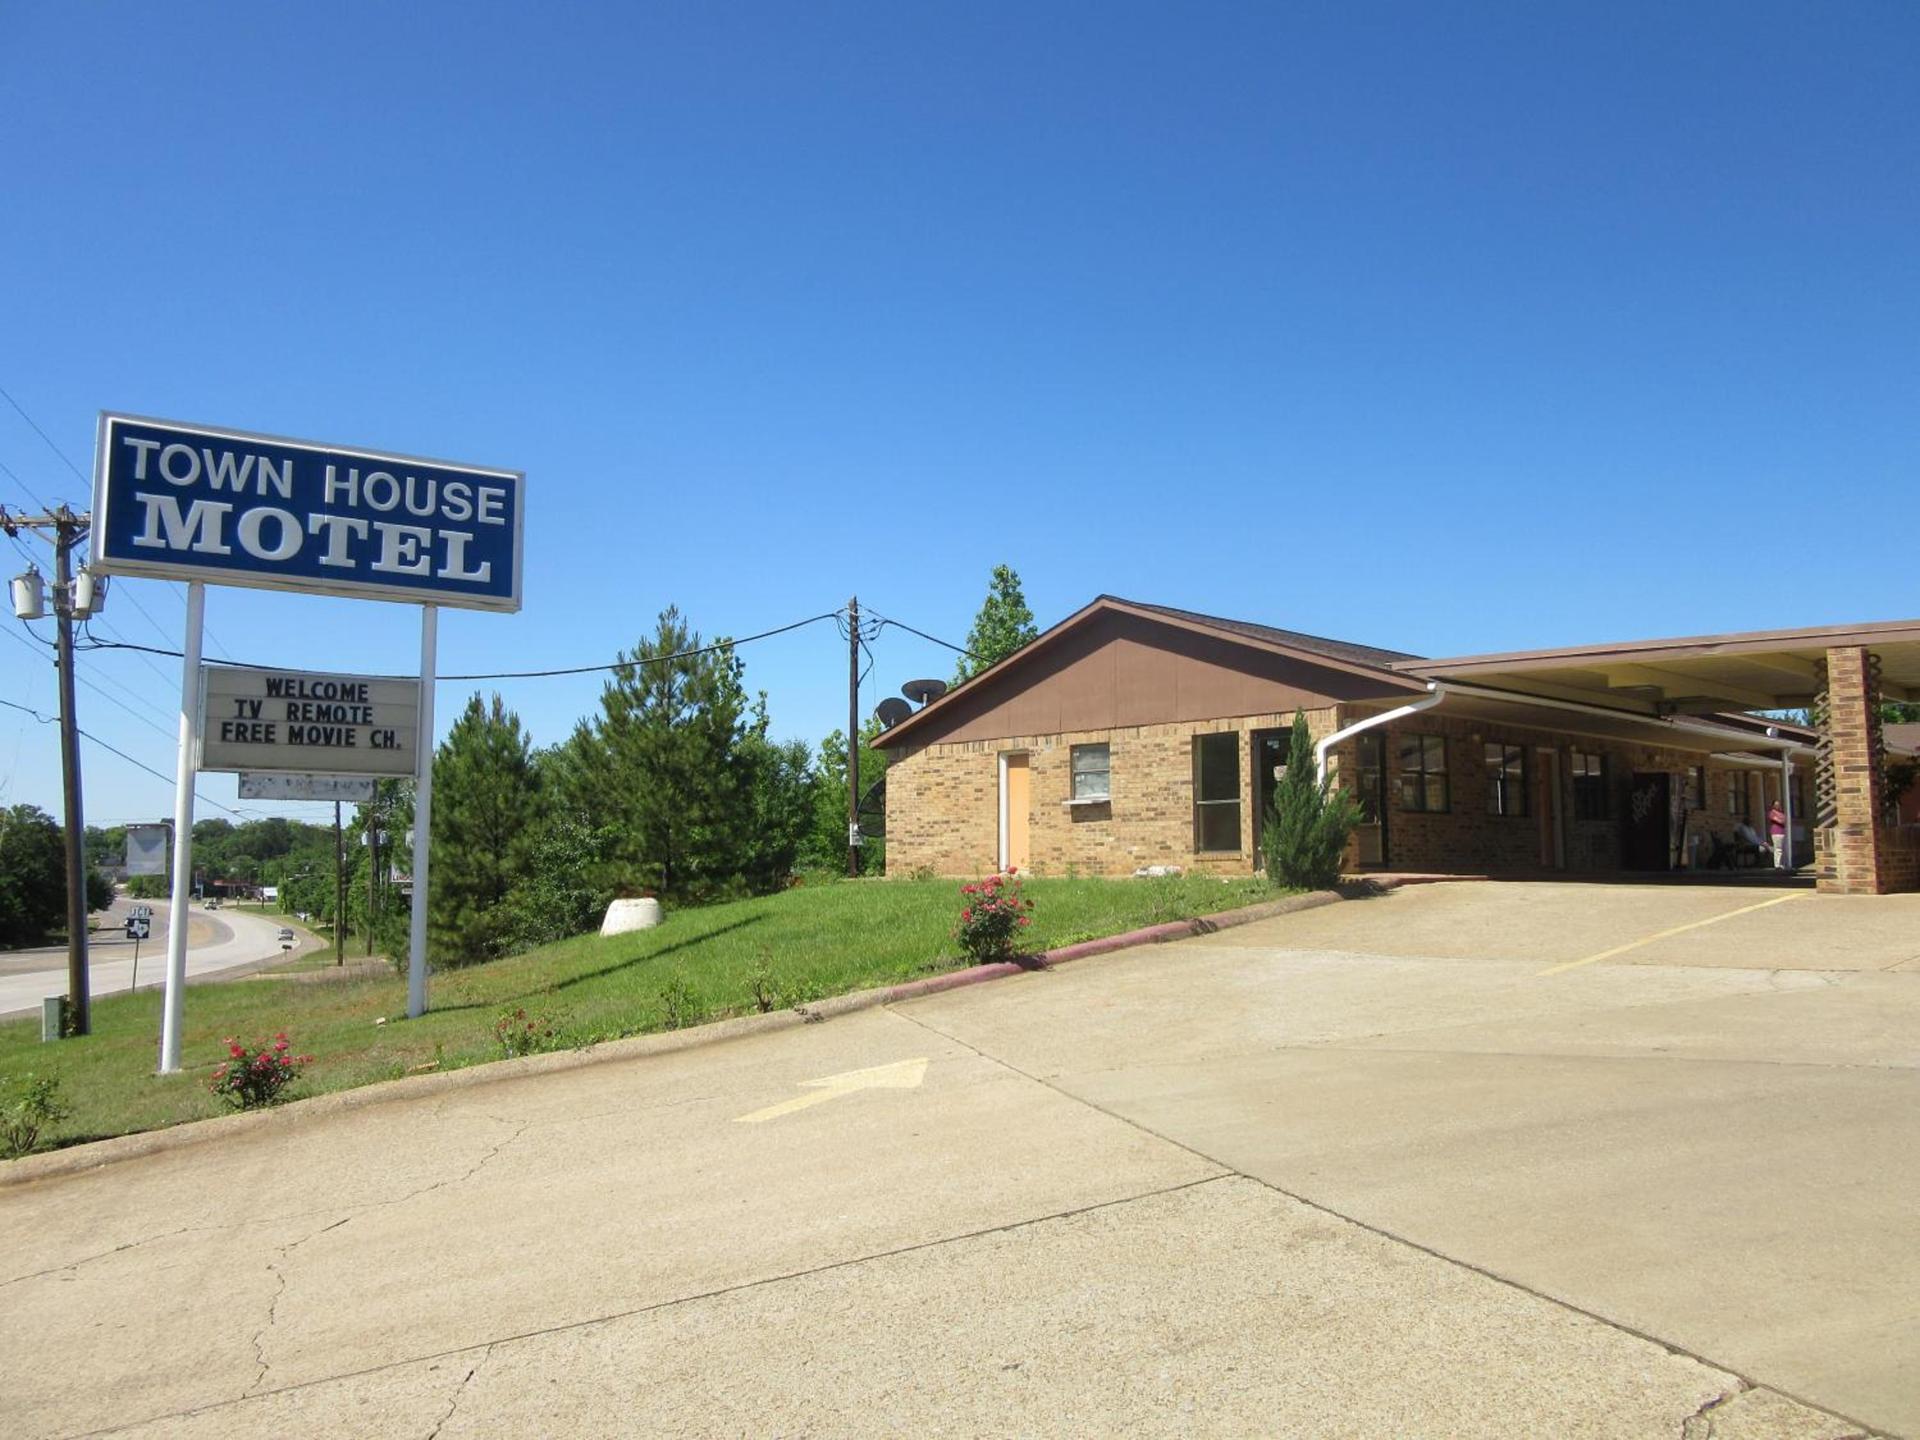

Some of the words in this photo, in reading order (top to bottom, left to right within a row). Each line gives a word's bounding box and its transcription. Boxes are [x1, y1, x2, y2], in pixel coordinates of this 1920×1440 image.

[123, 436, 293, 498] TOWN
[324, 464, 506, 525] HOUSE
[132, 491, 491, 583] MOTEL
[266, 677, 369, 701] WELCOME
[234, 699, 263, 719] TV
[286, 702, 374, 725] REMOTE
[221, 721, 276, 744] FREE
[288, 725, 356, 747] MOVIE
[370, 729, 402, 750] CH.
